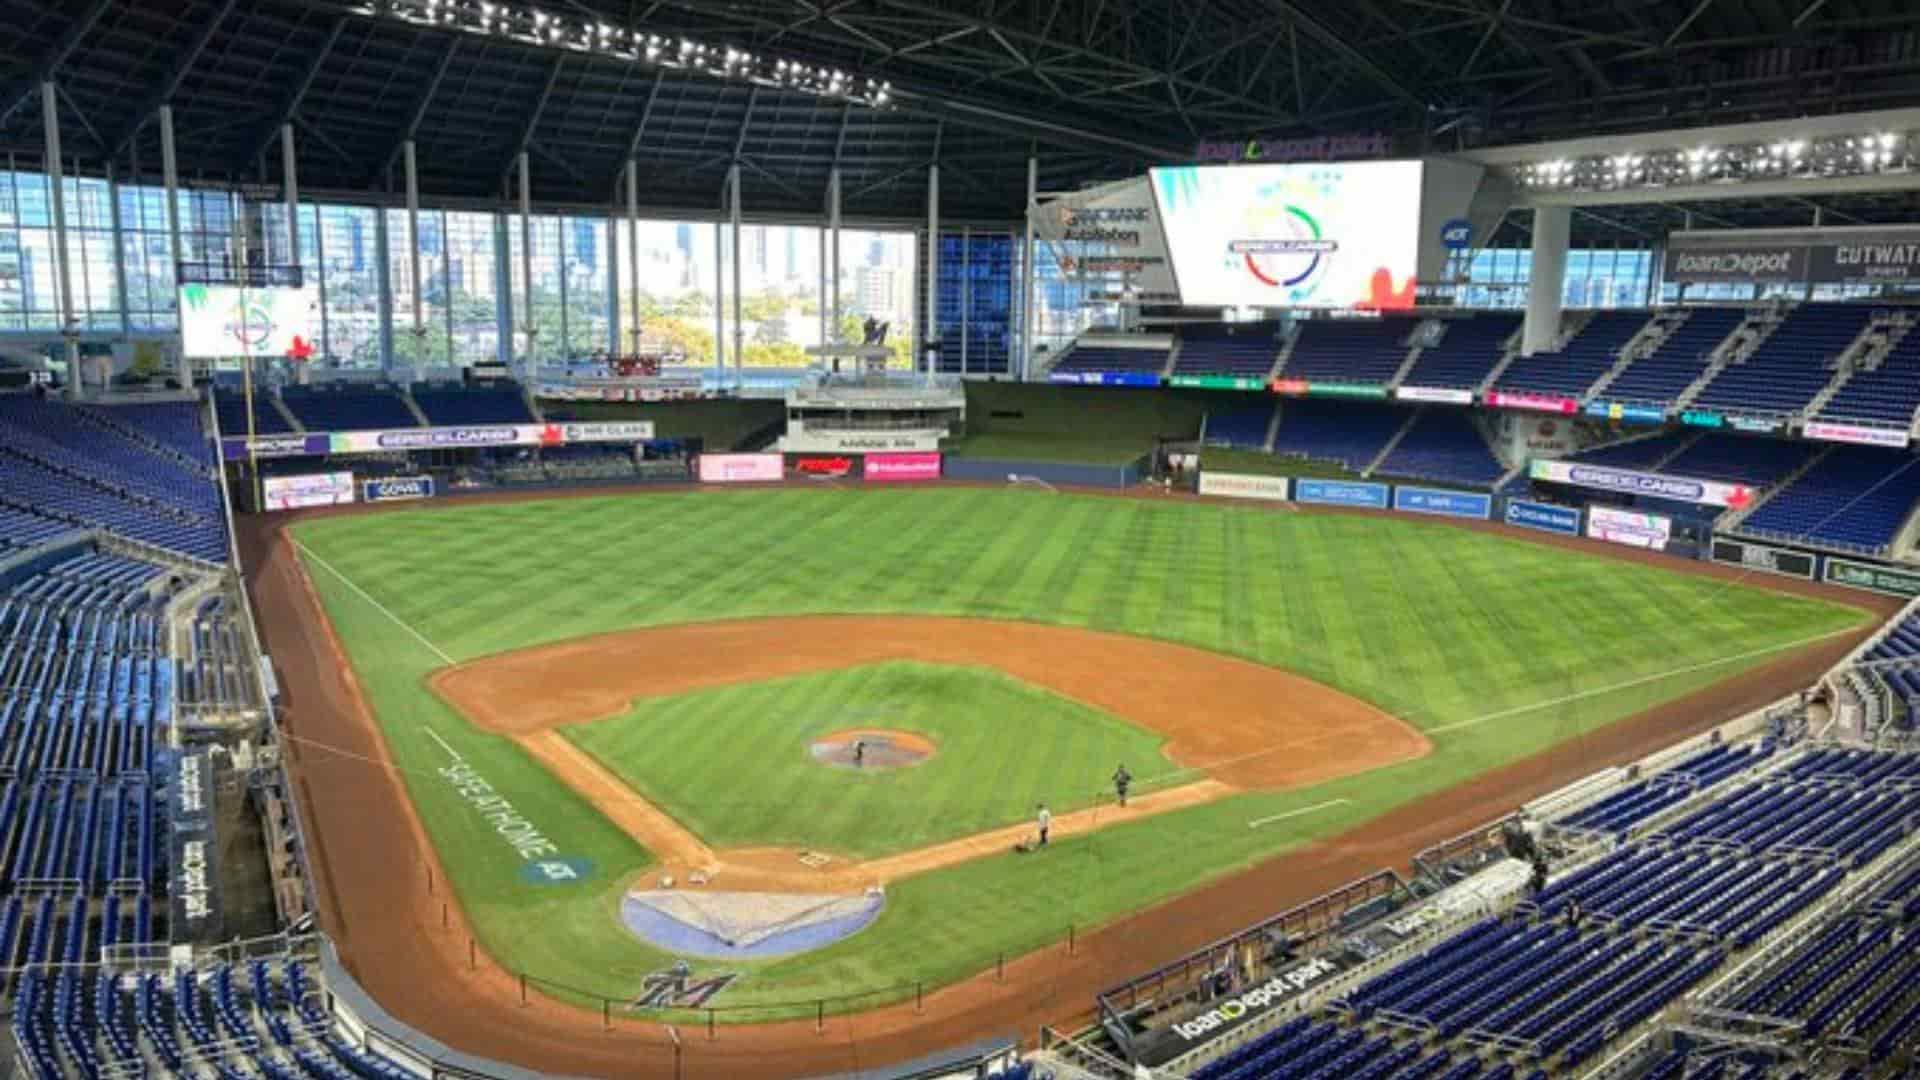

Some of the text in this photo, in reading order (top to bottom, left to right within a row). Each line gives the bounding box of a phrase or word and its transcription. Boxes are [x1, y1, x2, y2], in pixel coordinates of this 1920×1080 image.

[1676, 251, 1791, 274] loanDepot
[1836, 245, 1920, 264] CUTWAT
[1170, 957, 1336, 1040] loanDepot park
